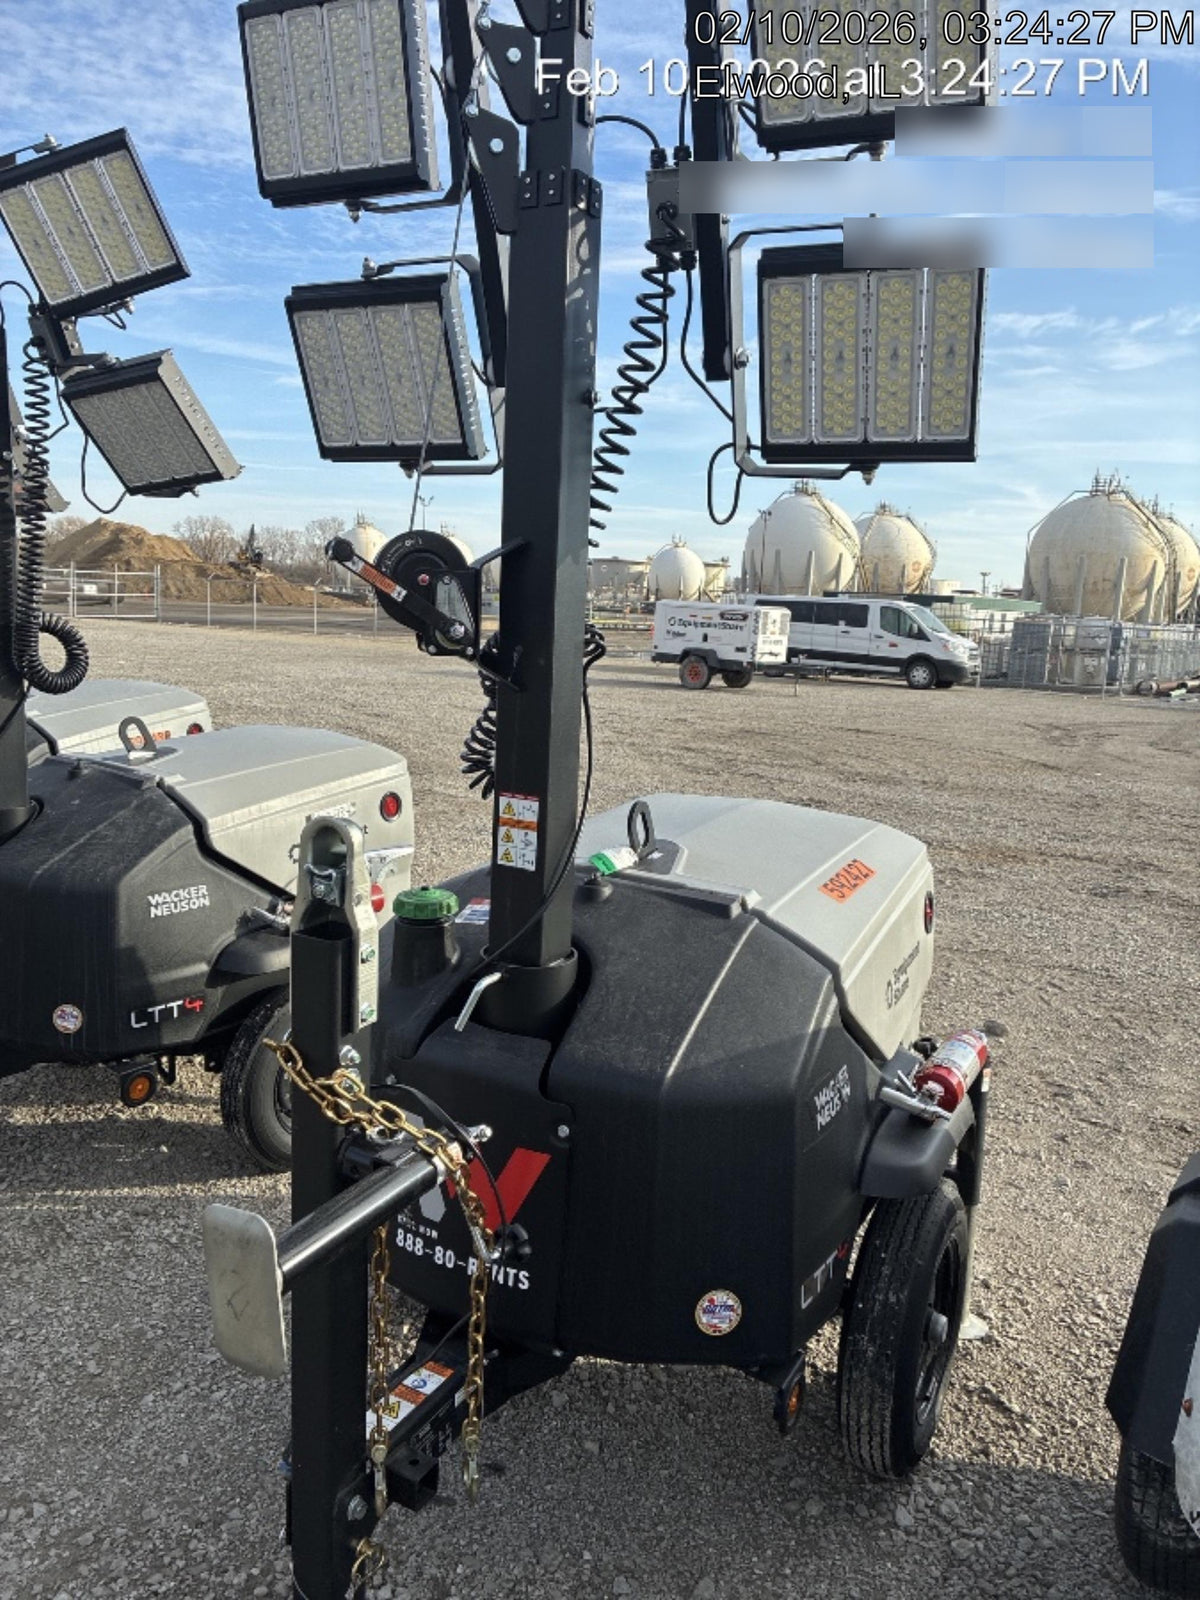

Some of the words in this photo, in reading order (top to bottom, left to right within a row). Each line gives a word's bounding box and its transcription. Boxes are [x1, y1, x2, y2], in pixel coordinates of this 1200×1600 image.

[147, 884, 208, 906] WACKER
[150, 896, 210, 918] NEUSON
[130, 998, 204, 1028] LTT4
[396, 1228, 530, 1290] 888-80-RNTS
